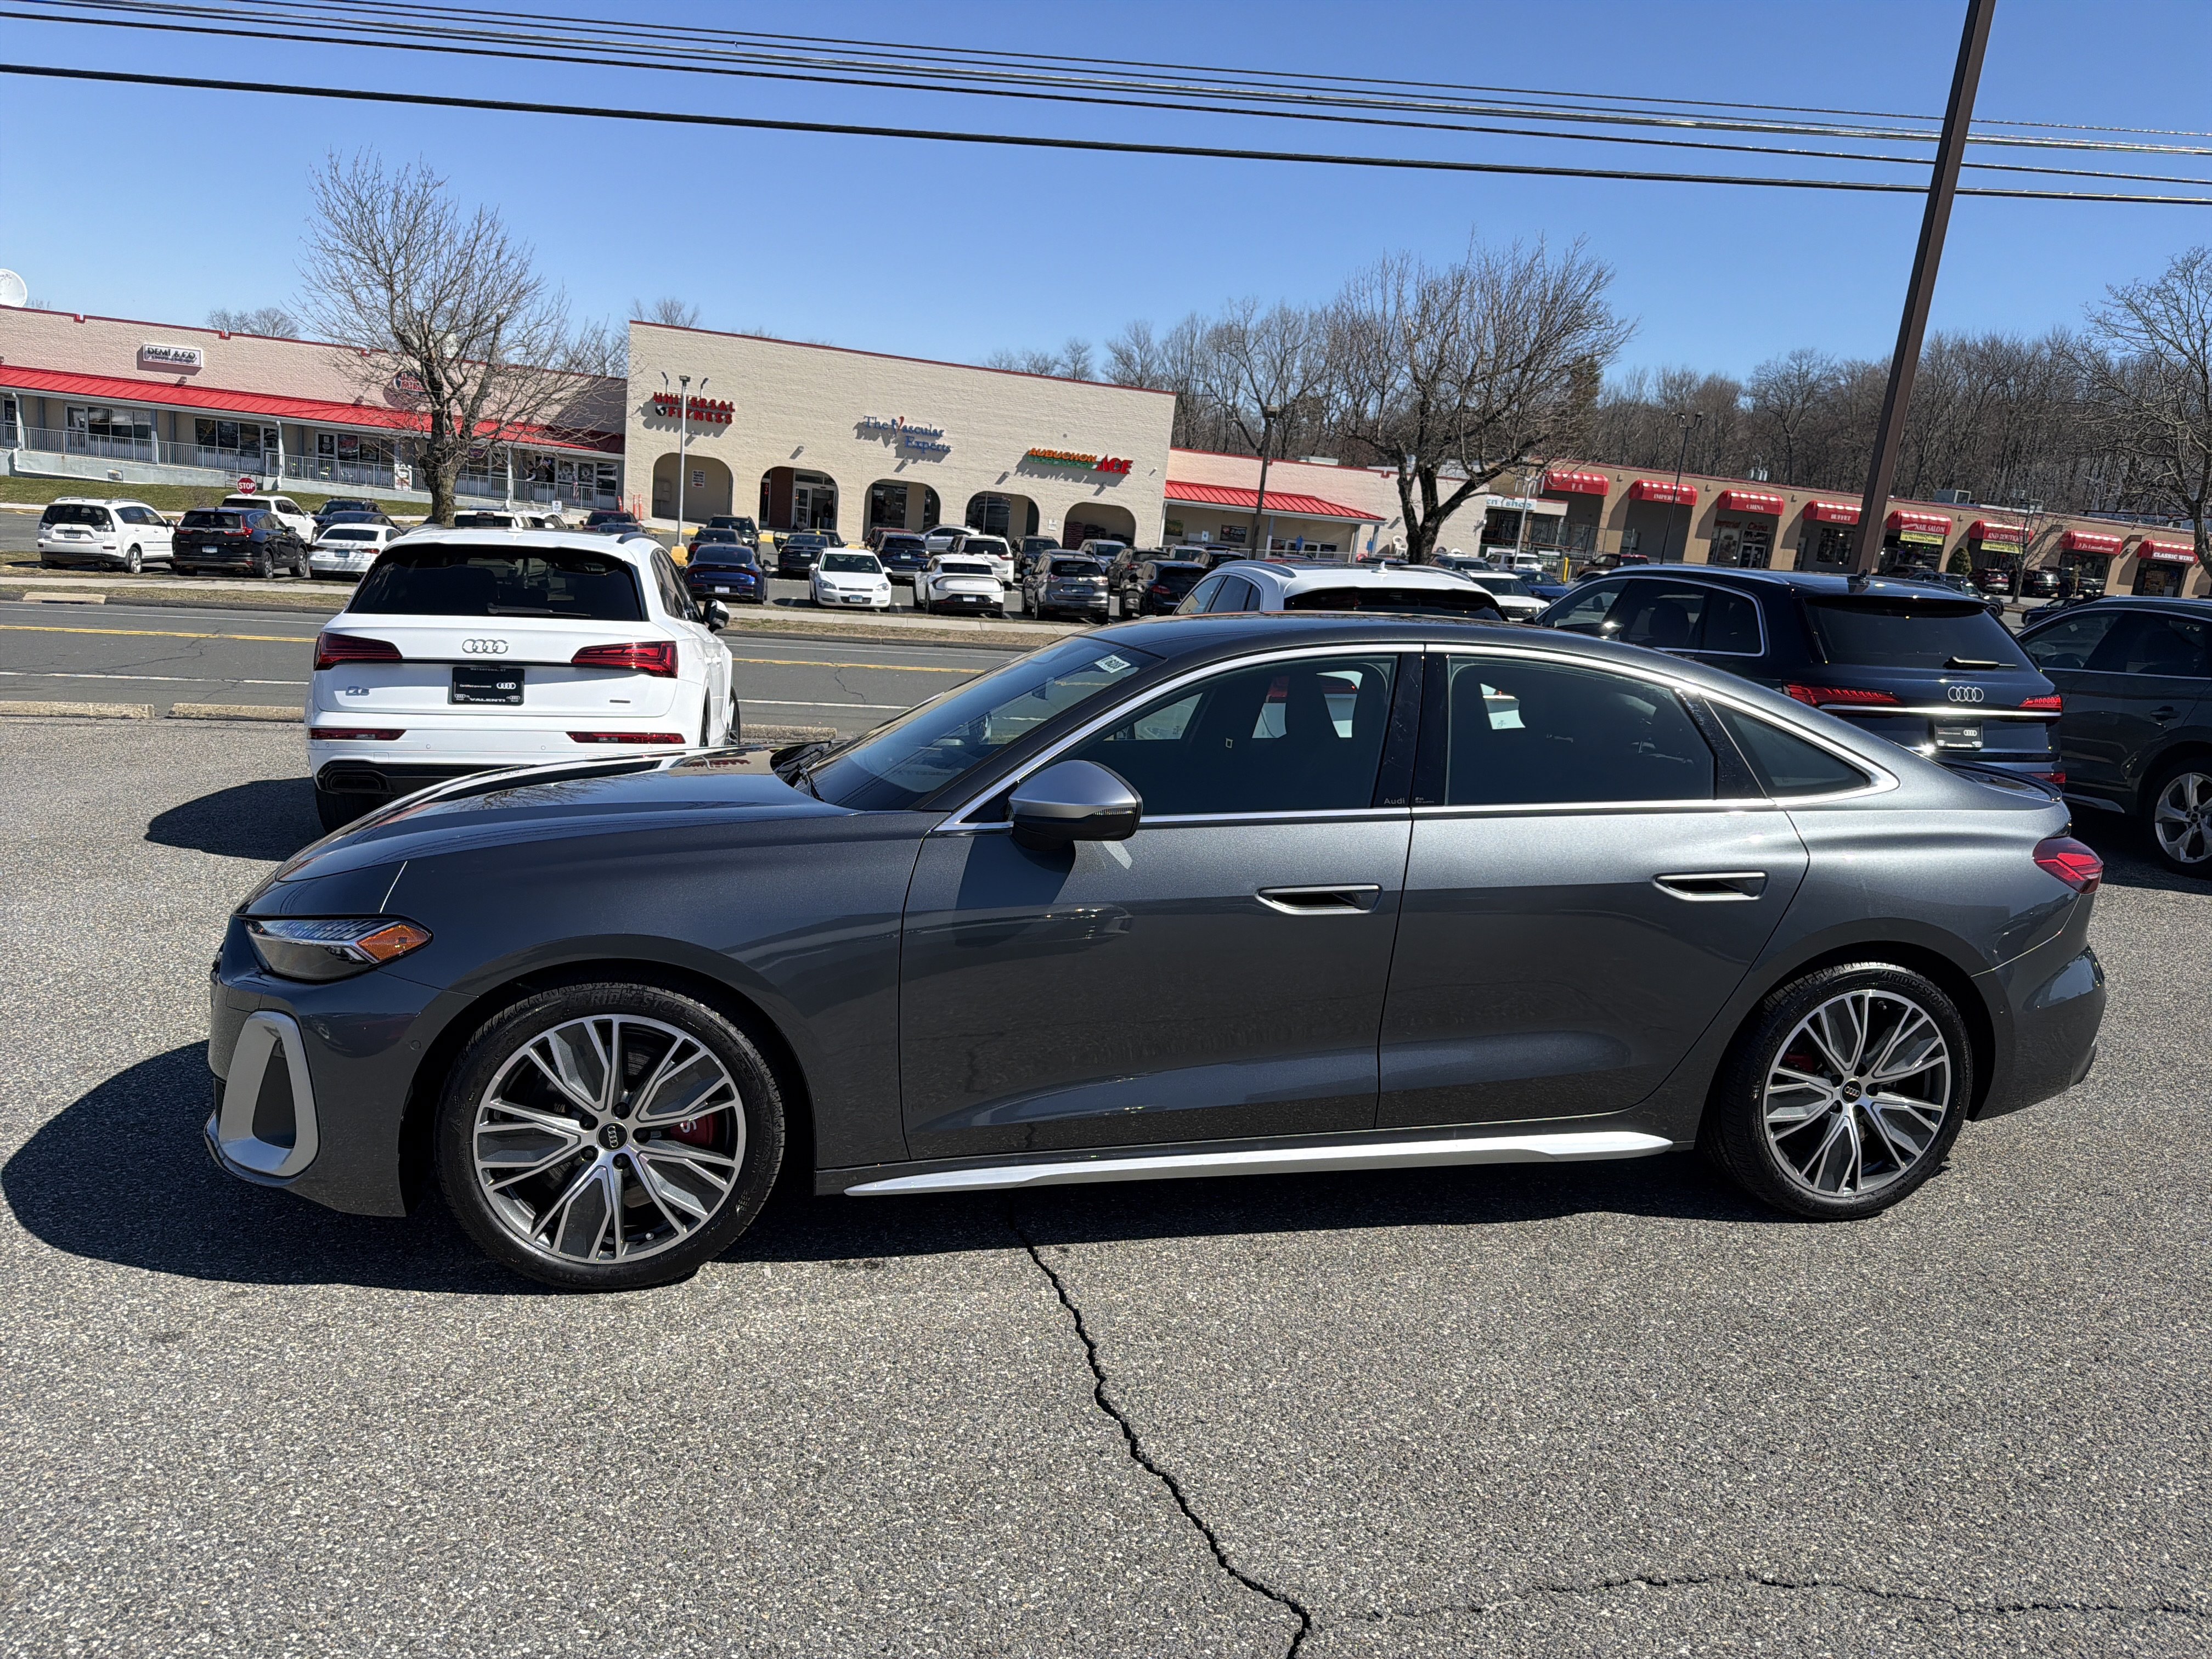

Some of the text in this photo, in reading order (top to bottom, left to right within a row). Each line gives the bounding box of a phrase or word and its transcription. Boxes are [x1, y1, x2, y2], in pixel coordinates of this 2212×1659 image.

[863, 415, 944, 437] The Vascular
[905, 436, 951, 454] Experts
[1028, 448, 1133, 475] AUBUCHON ACE
[1927, 524, 1945, 533] SALON
